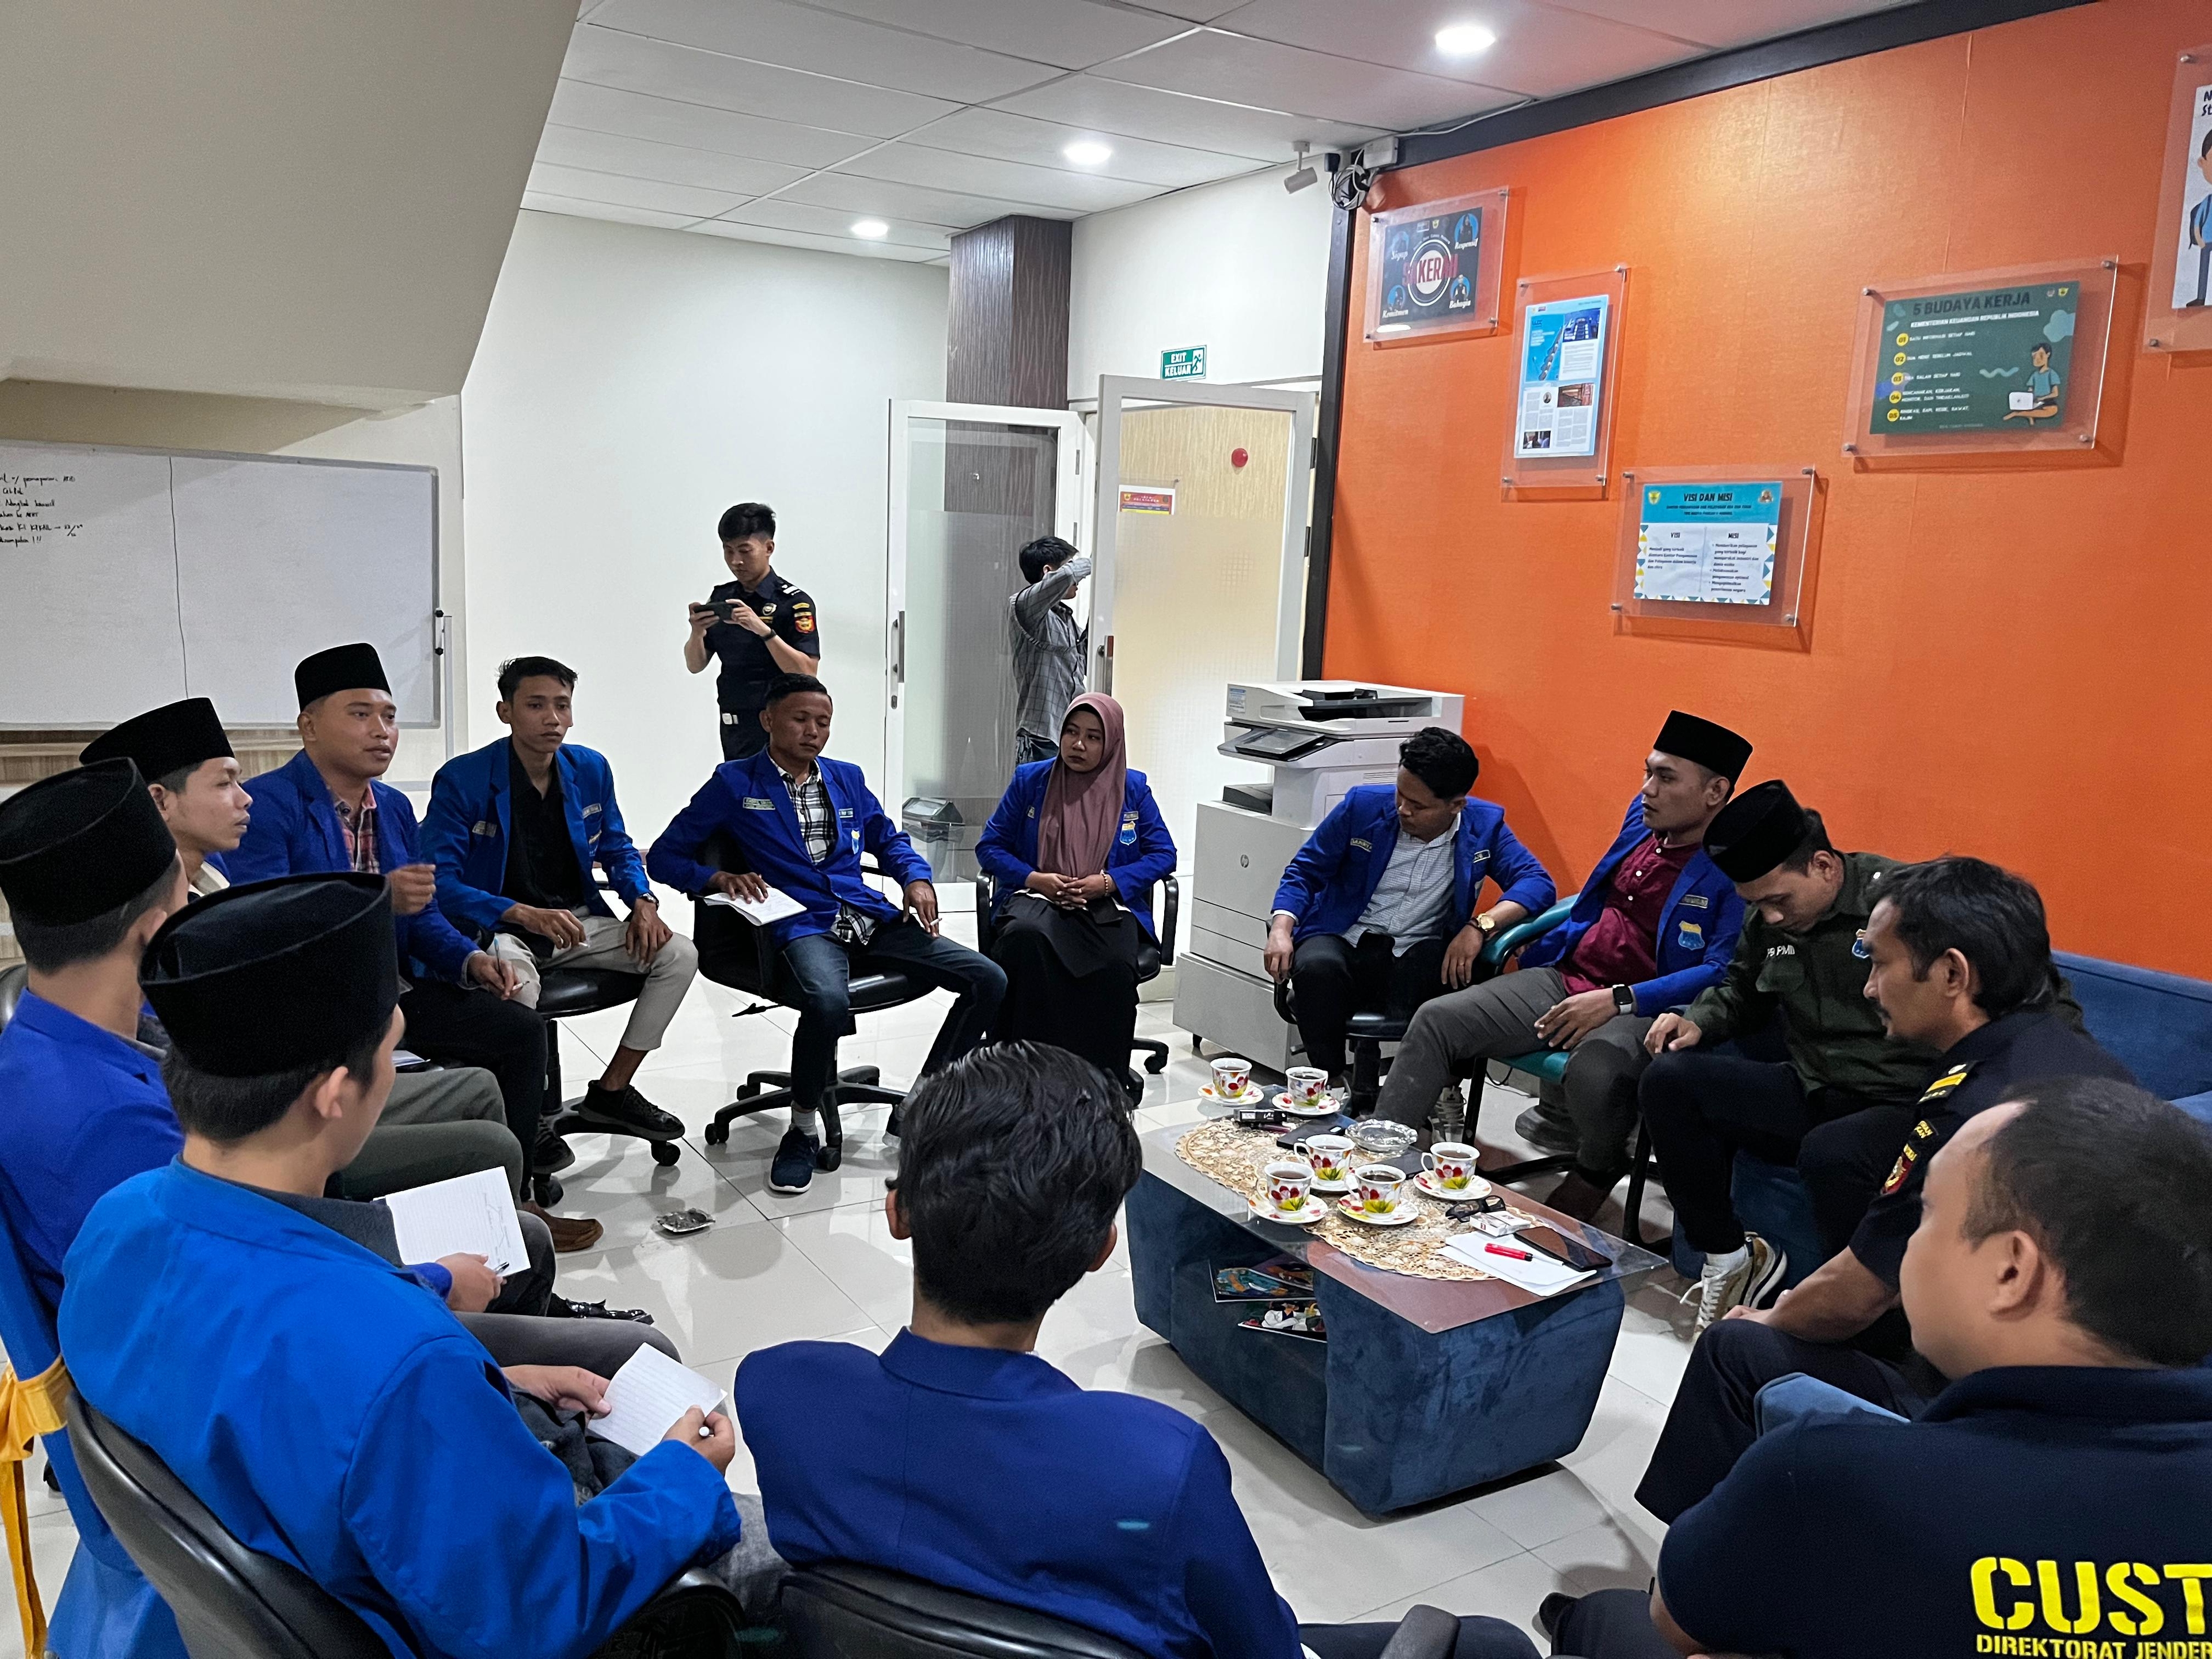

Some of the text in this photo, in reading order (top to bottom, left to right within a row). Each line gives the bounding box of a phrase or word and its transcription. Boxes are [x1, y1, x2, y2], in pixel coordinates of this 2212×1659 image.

[1402, 253, 1459, 286] SAKERAH
[1912, 292, 2030, 316] 5 BUDAYA KERJA
[1171, 352, 1187, 363] EXIT
[1165, 365, 1191, 377] KELUAR
[1684, 493, 1732, 501] VISI DAN MISI
[1971, 1557, 2212, 1635] CUST
[1977, 1634, 2126, 1659] DIREKTORAT
